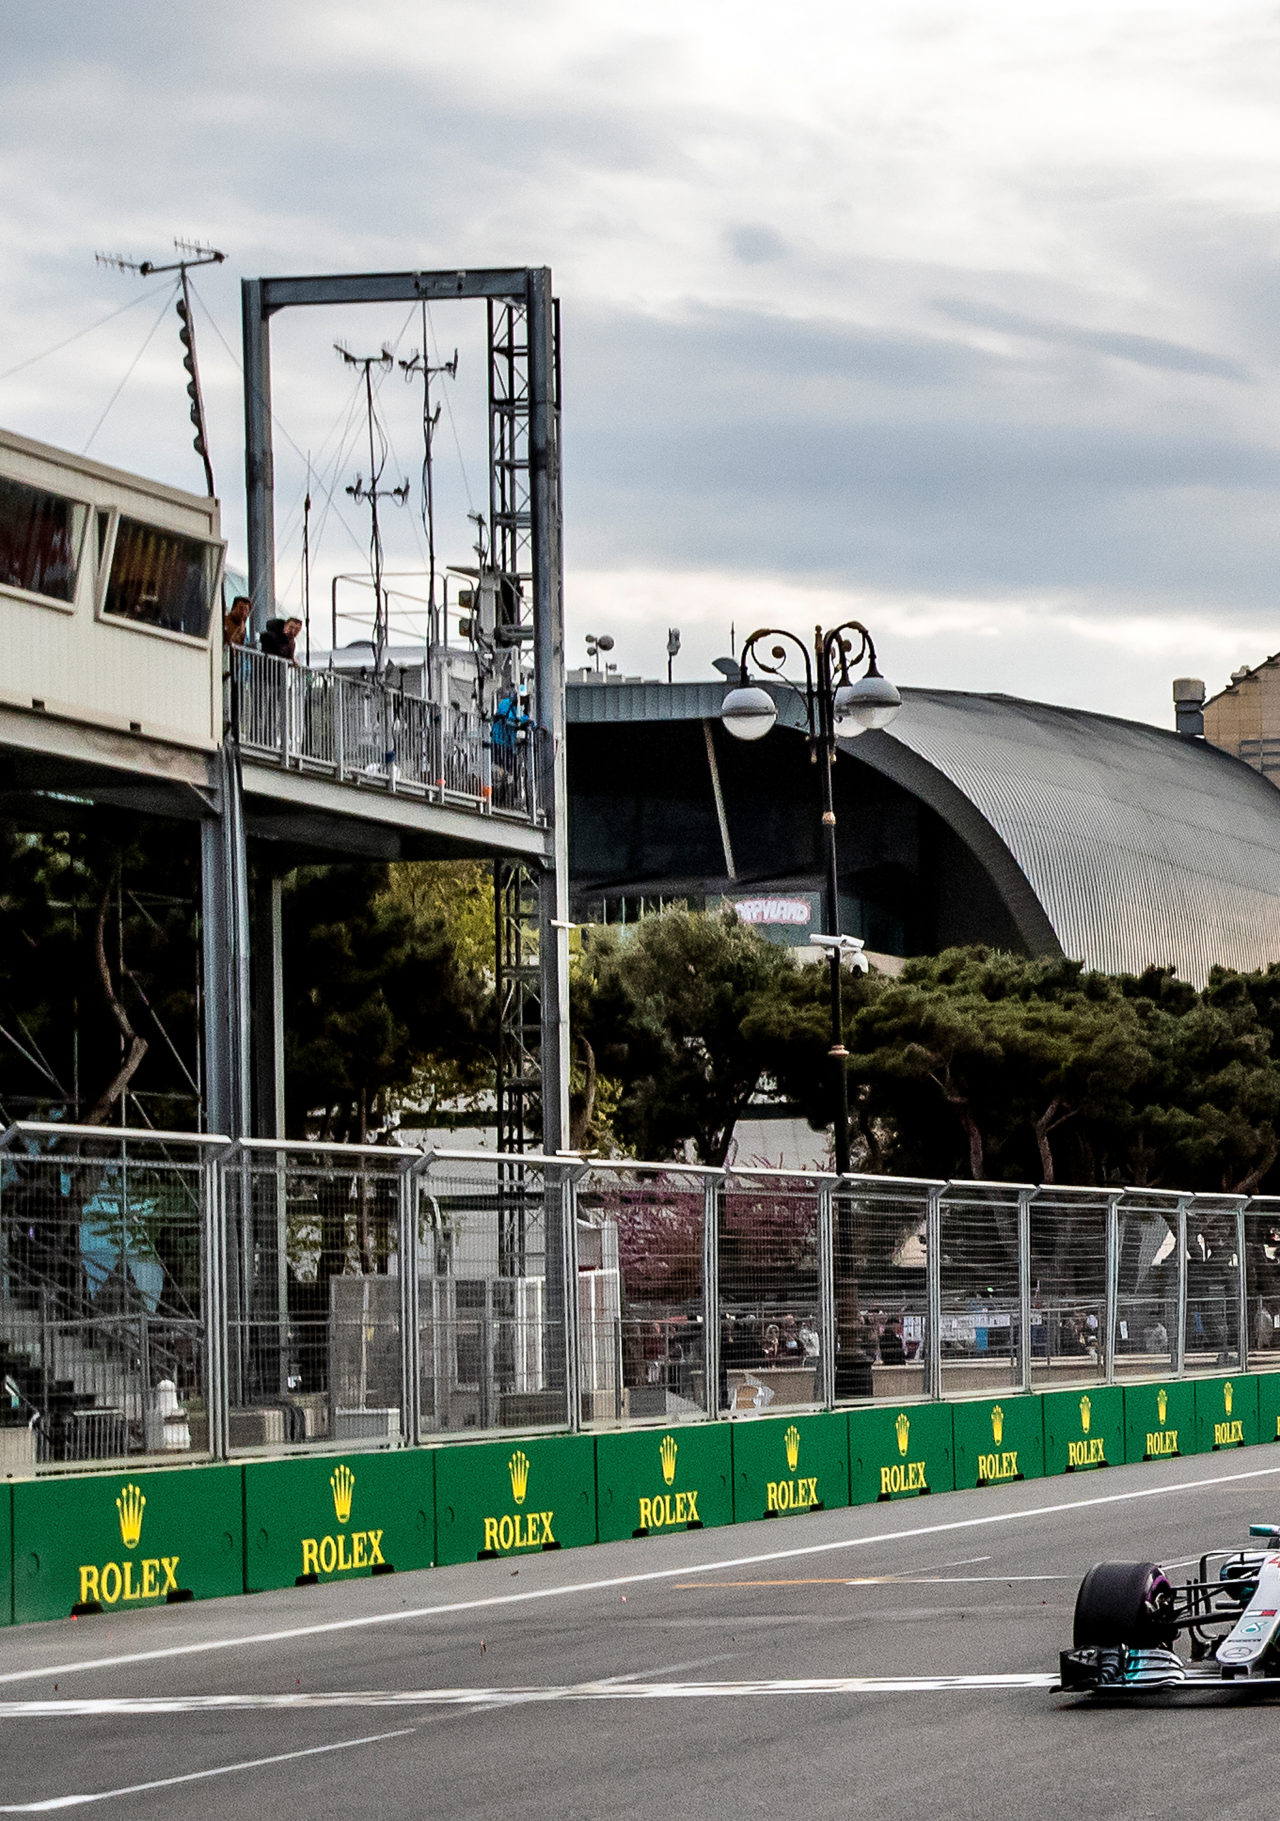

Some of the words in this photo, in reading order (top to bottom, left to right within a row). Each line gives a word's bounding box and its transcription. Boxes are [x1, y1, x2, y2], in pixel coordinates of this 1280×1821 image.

[1146, 1431, 1178, 1455] ROLEX
[1215, 1421, 1244, 1445] ROLEX
[978, 1451, 1018, 1480] ROLEX
[1068, 1438, 1105, 1466] ROLEX
[767, 1477, 818, 1511] ROLEX
[881, 1462, 927, 1495] ROLEX
[638, 1491, 699, 1529] ROLEX
[484, 1512, 554, 1551] ROLEX
[302, 1529, 385, 1575] ROLEX
[79, 1556, 180, 1604] ROLEX
